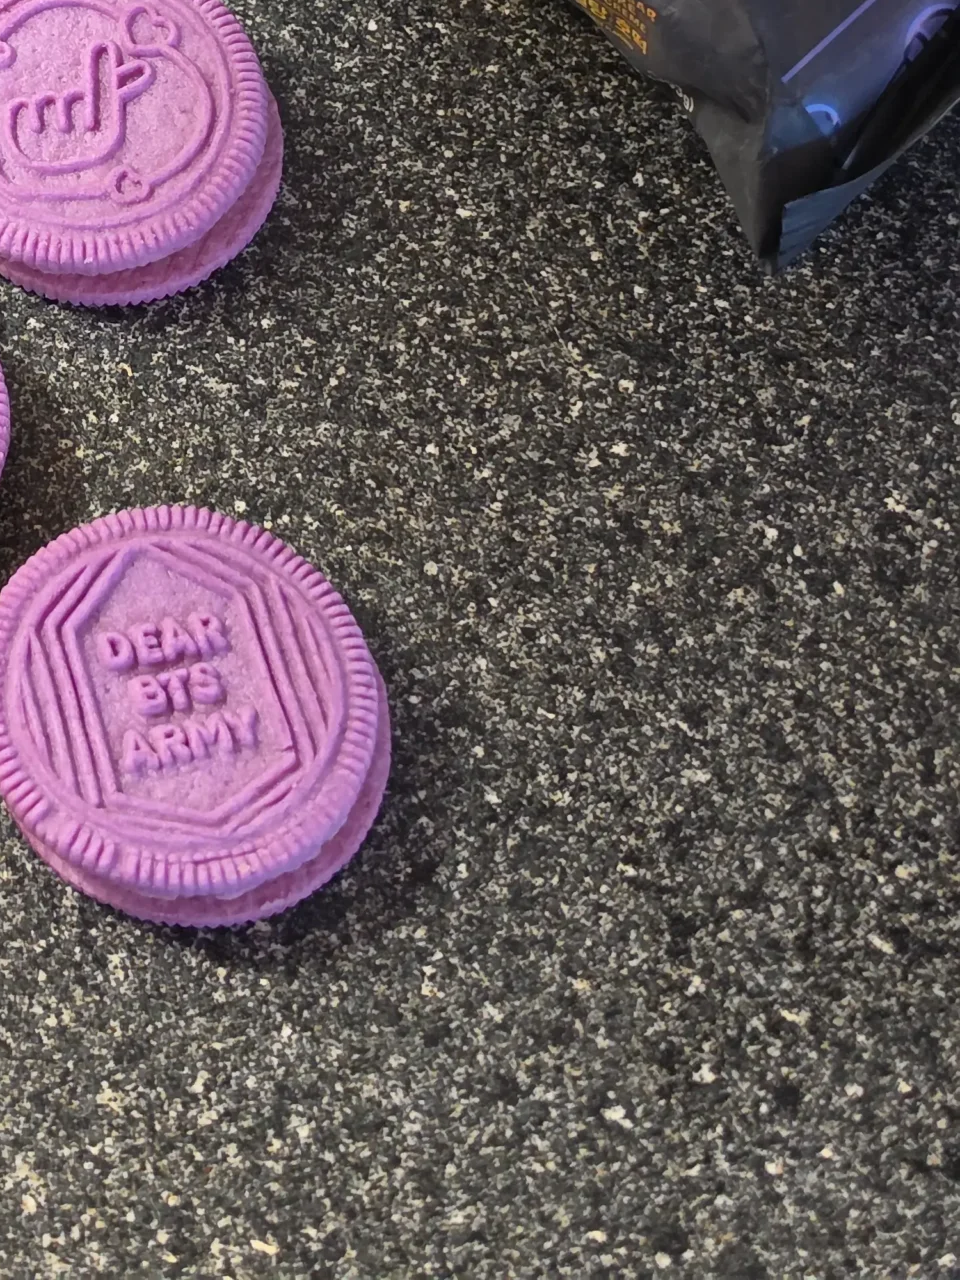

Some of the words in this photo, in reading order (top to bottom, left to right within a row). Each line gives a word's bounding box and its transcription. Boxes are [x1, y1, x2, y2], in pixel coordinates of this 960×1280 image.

[98, 611, 231, 671] DEAR
[128, 661, 225, 718] BTS
[120, 705, 259, 774] ARMY
